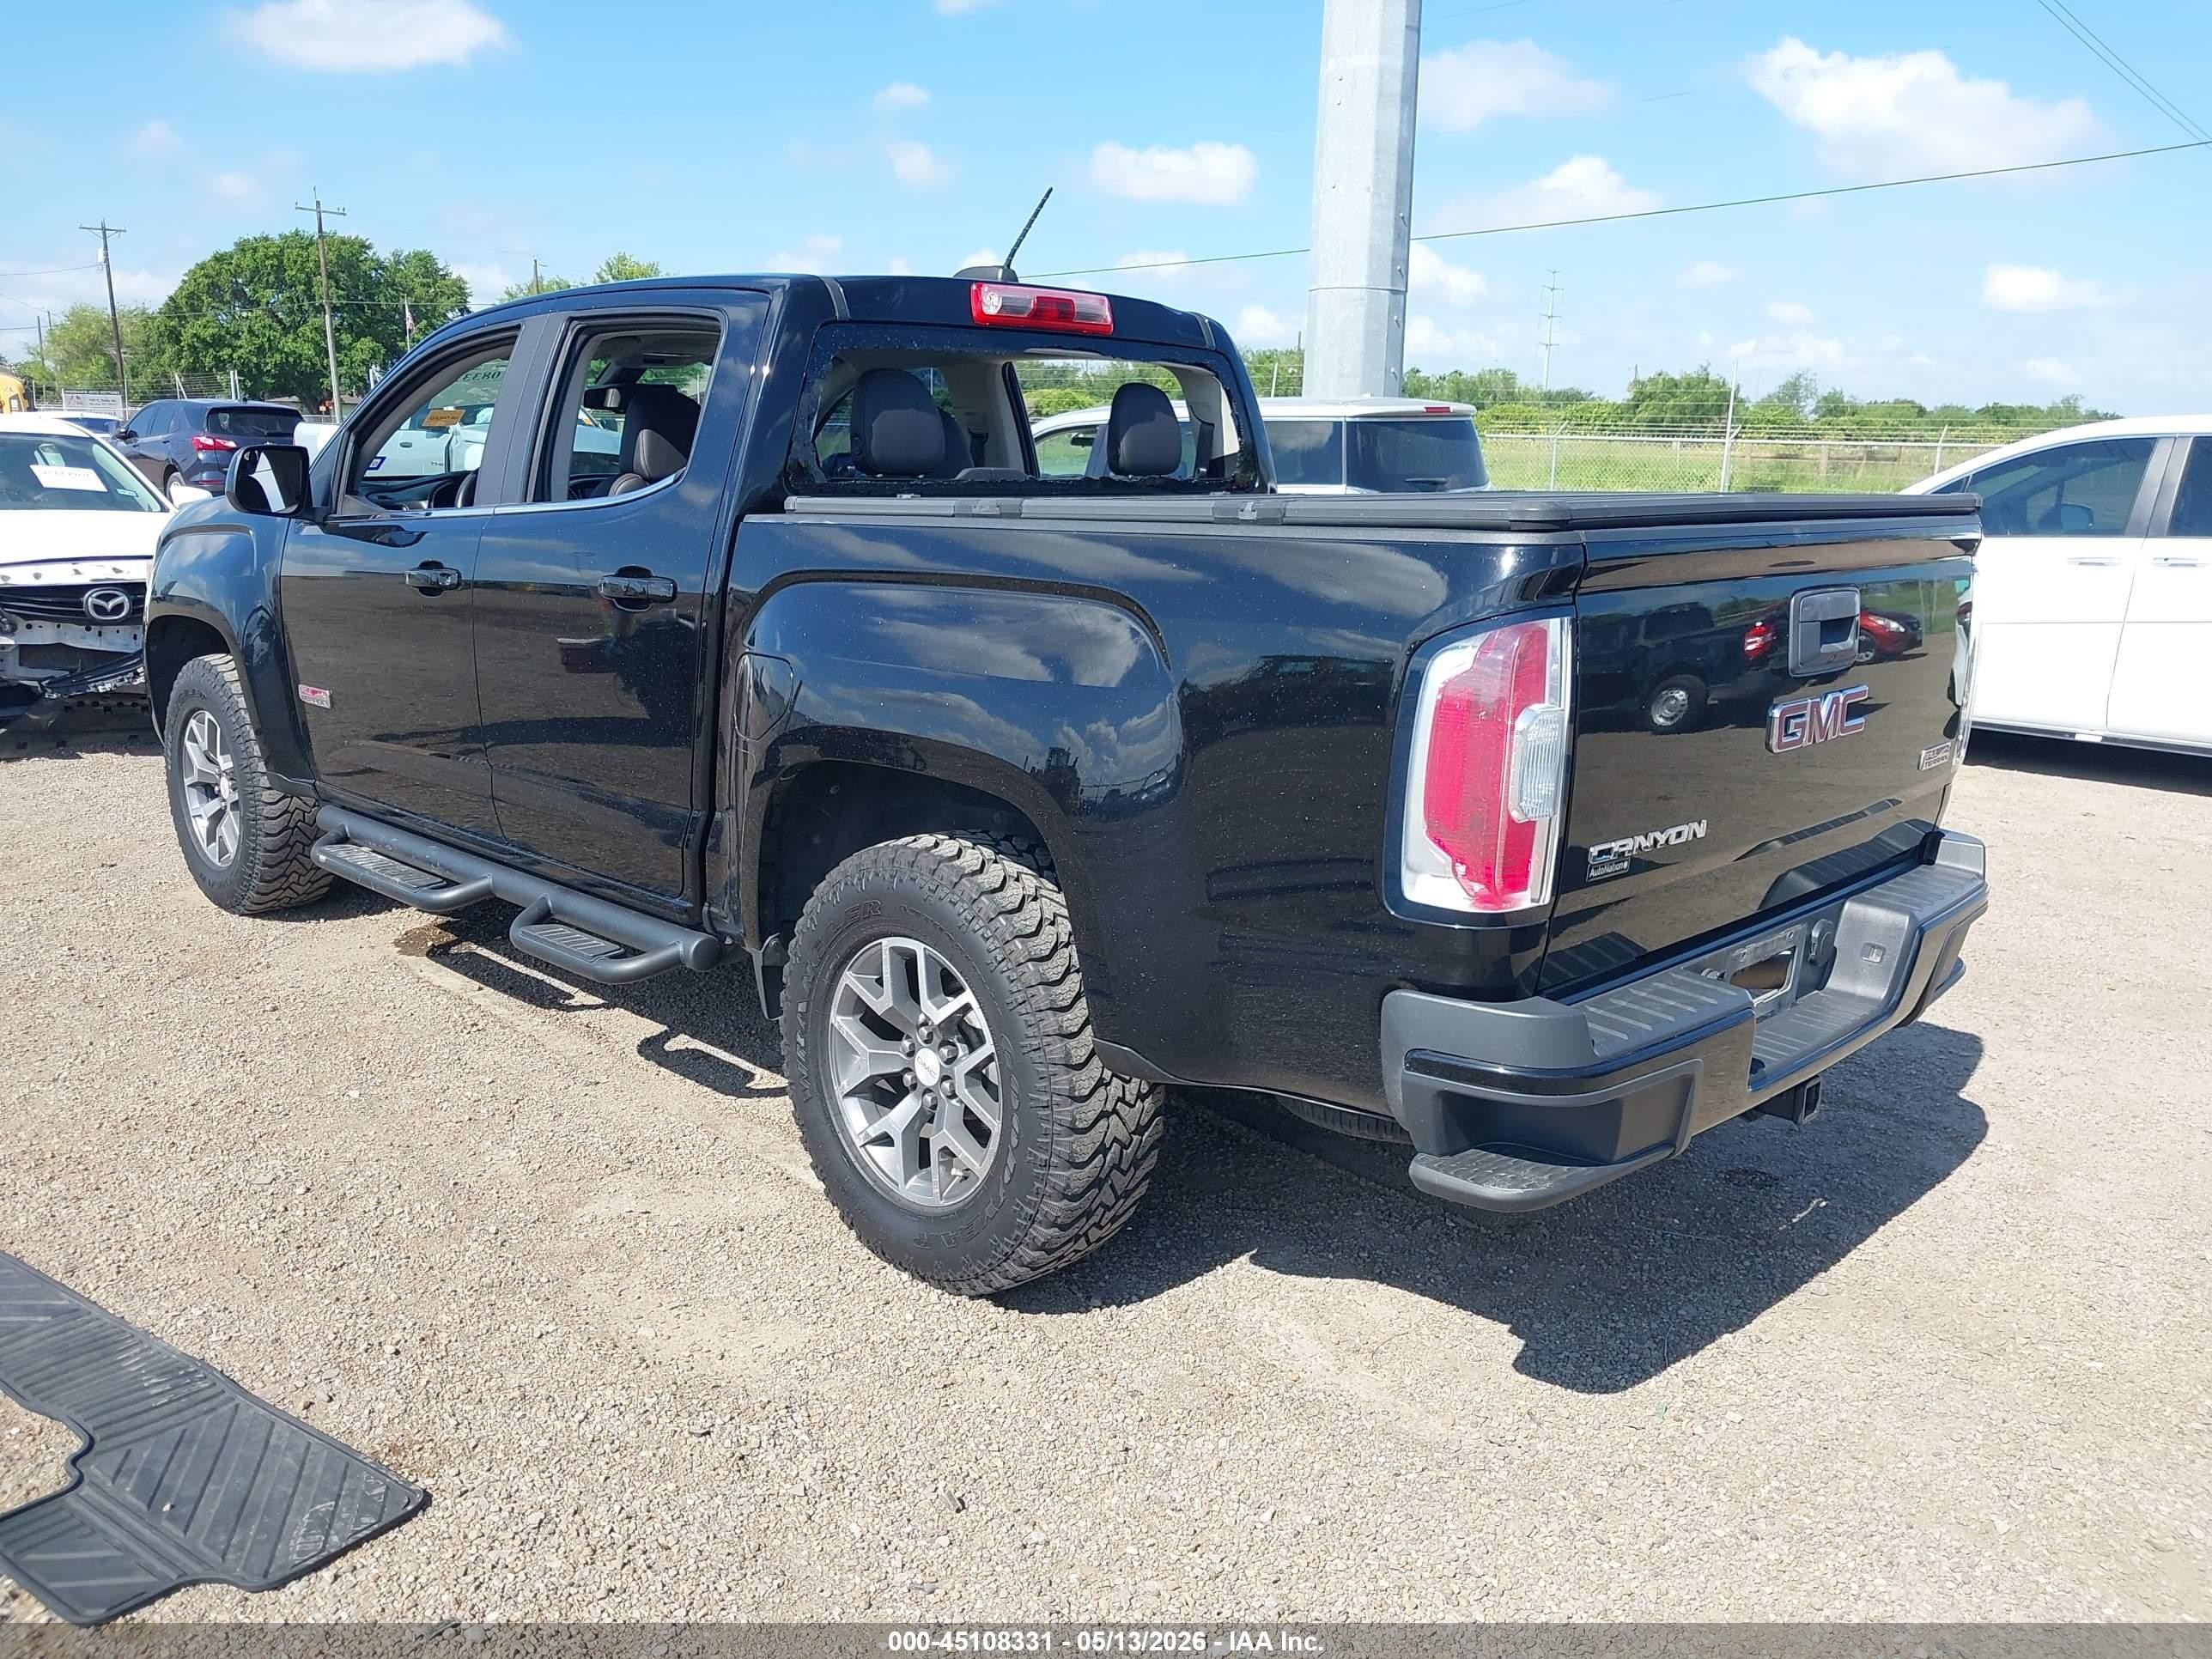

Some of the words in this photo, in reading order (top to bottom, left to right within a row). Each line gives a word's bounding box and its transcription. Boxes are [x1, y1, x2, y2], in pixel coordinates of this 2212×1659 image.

[1766, 685, 1869, 753] GMC
[1589, 819, 1708, 865] CANYON
[1589, 860, 1625, 878] AutoNation
[916, 1055, 937, 1079] GMC
[913, 1033, 1020, 1250] GOODYEAR
